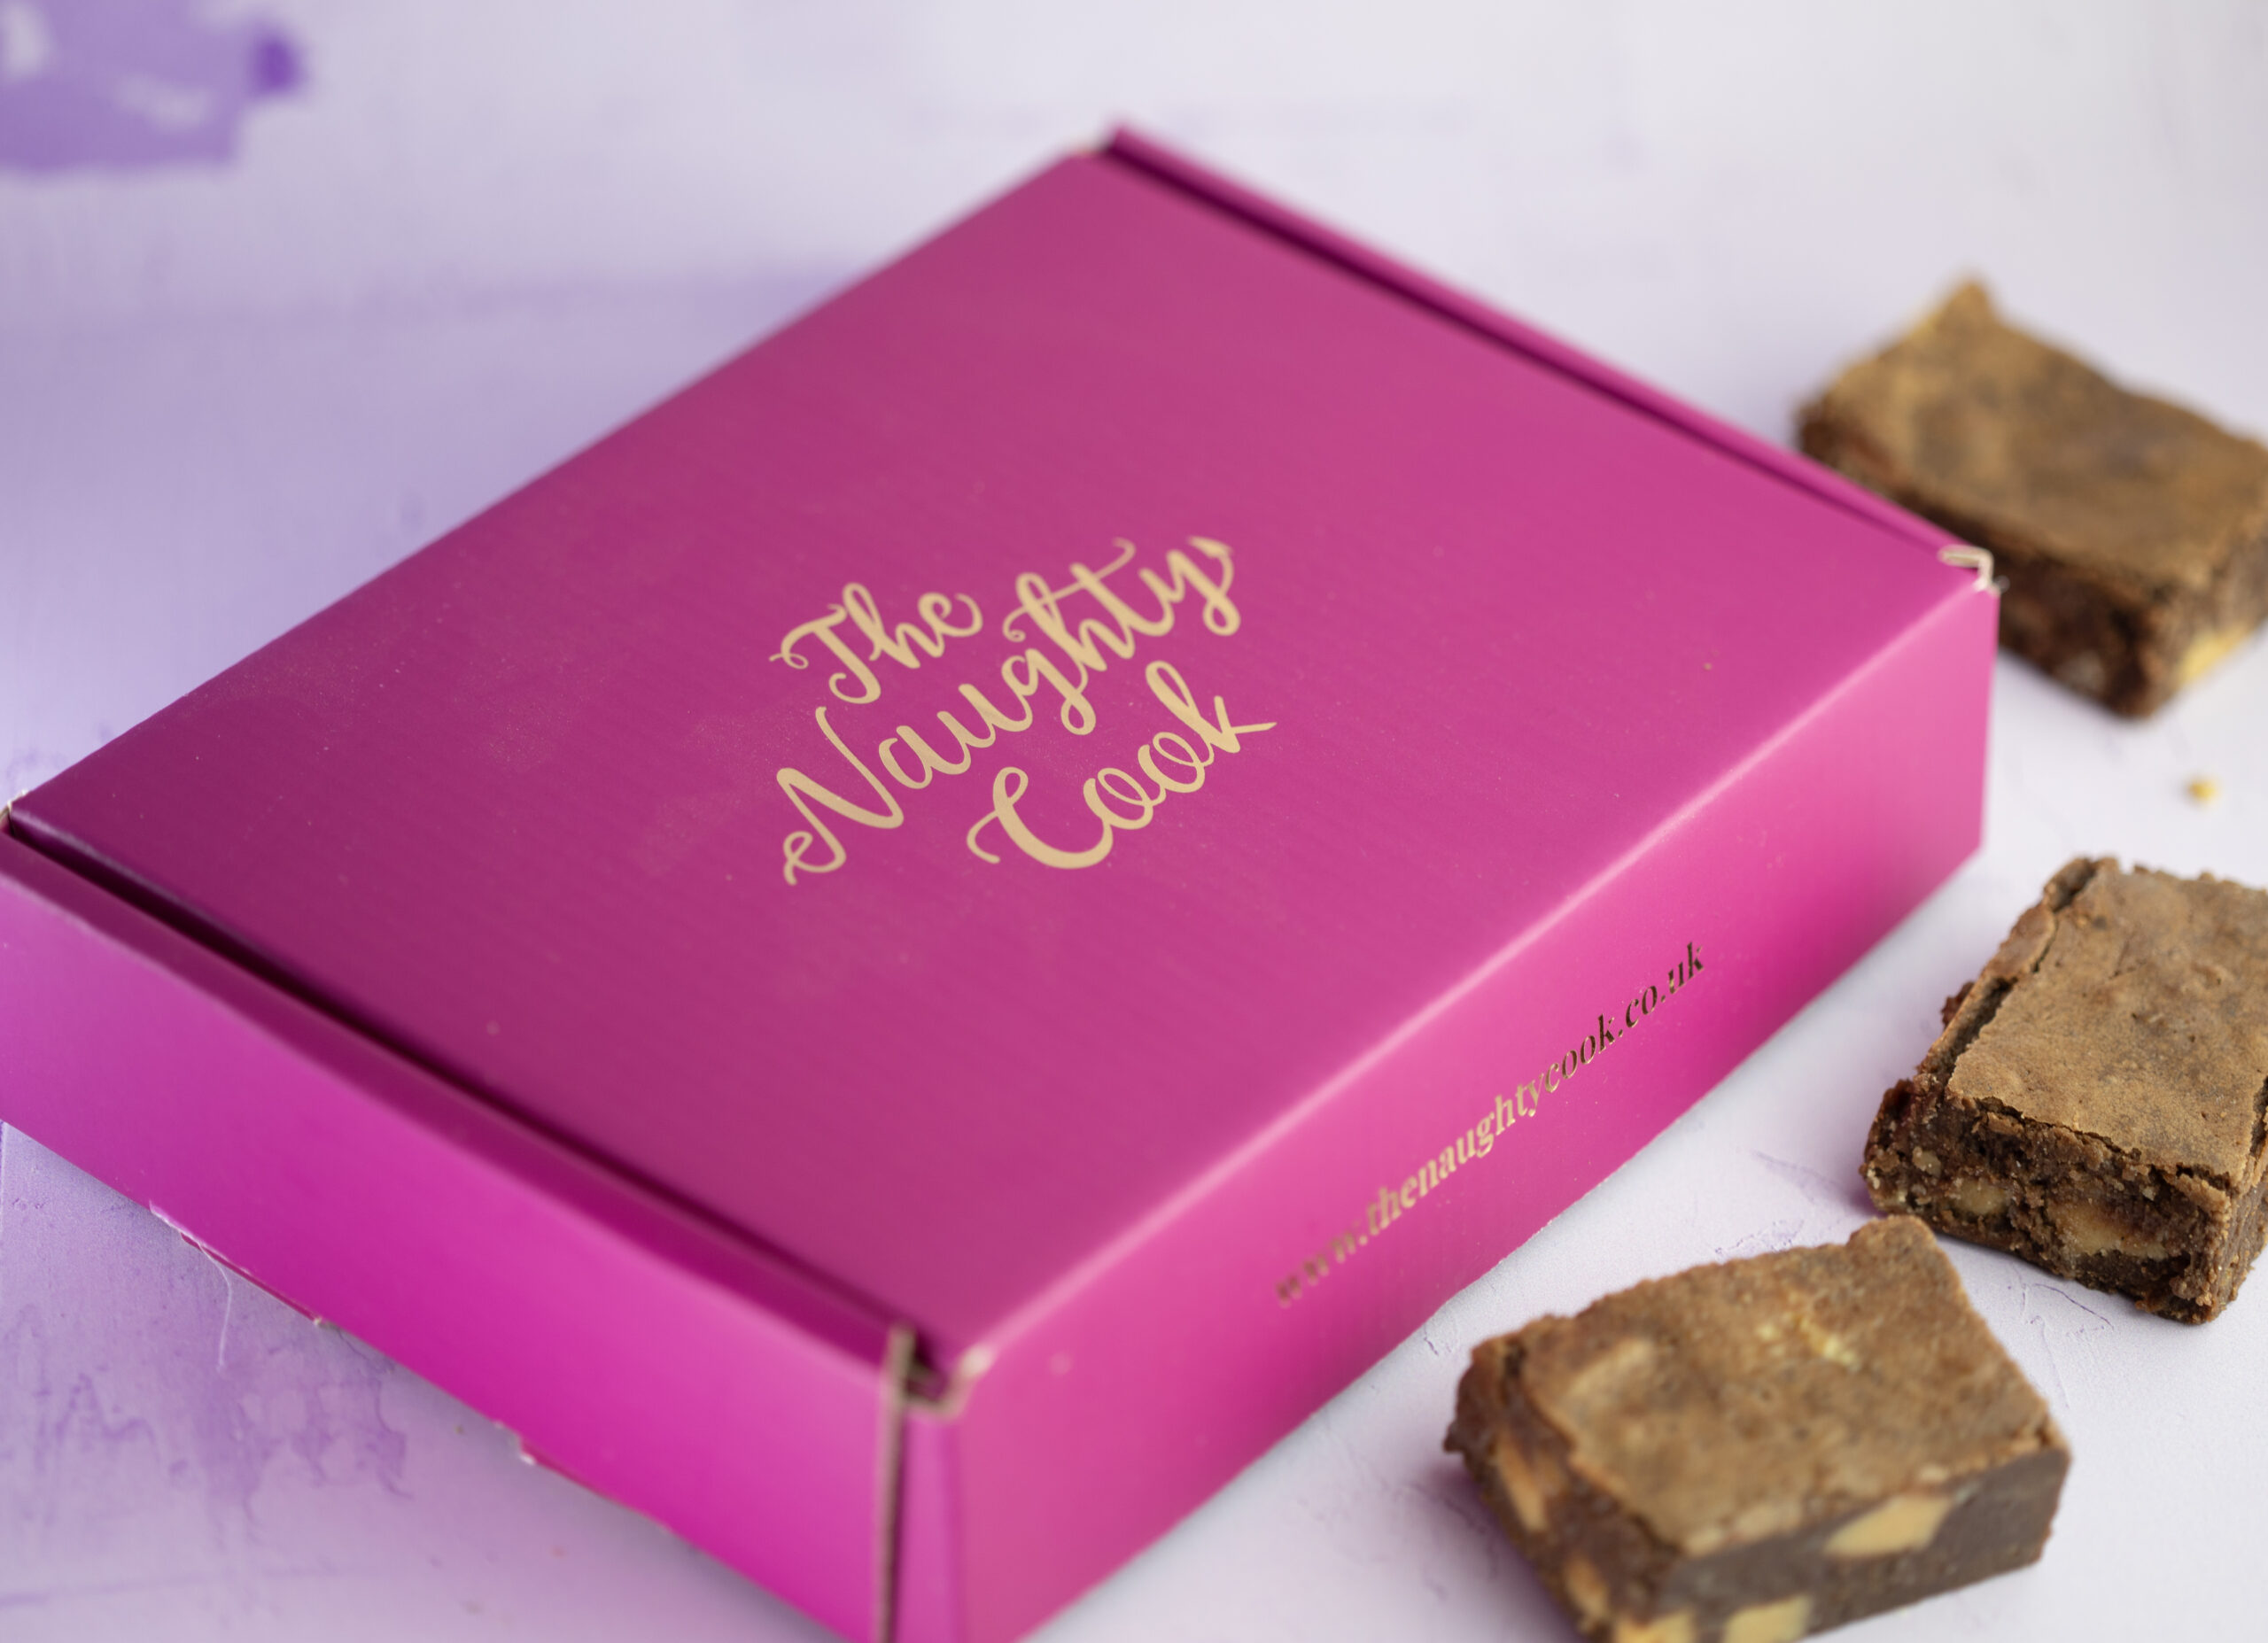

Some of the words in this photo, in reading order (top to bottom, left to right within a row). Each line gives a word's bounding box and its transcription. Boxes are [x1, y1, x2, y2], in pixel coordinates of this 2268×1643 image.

[769, 582, 983, 705] The
[776, 535, 1241, 886] Naughty
[967, 660, 1278, 870] Cook
[1274, 941, 1706, 1309] www.thenaughtycook.co.uk
